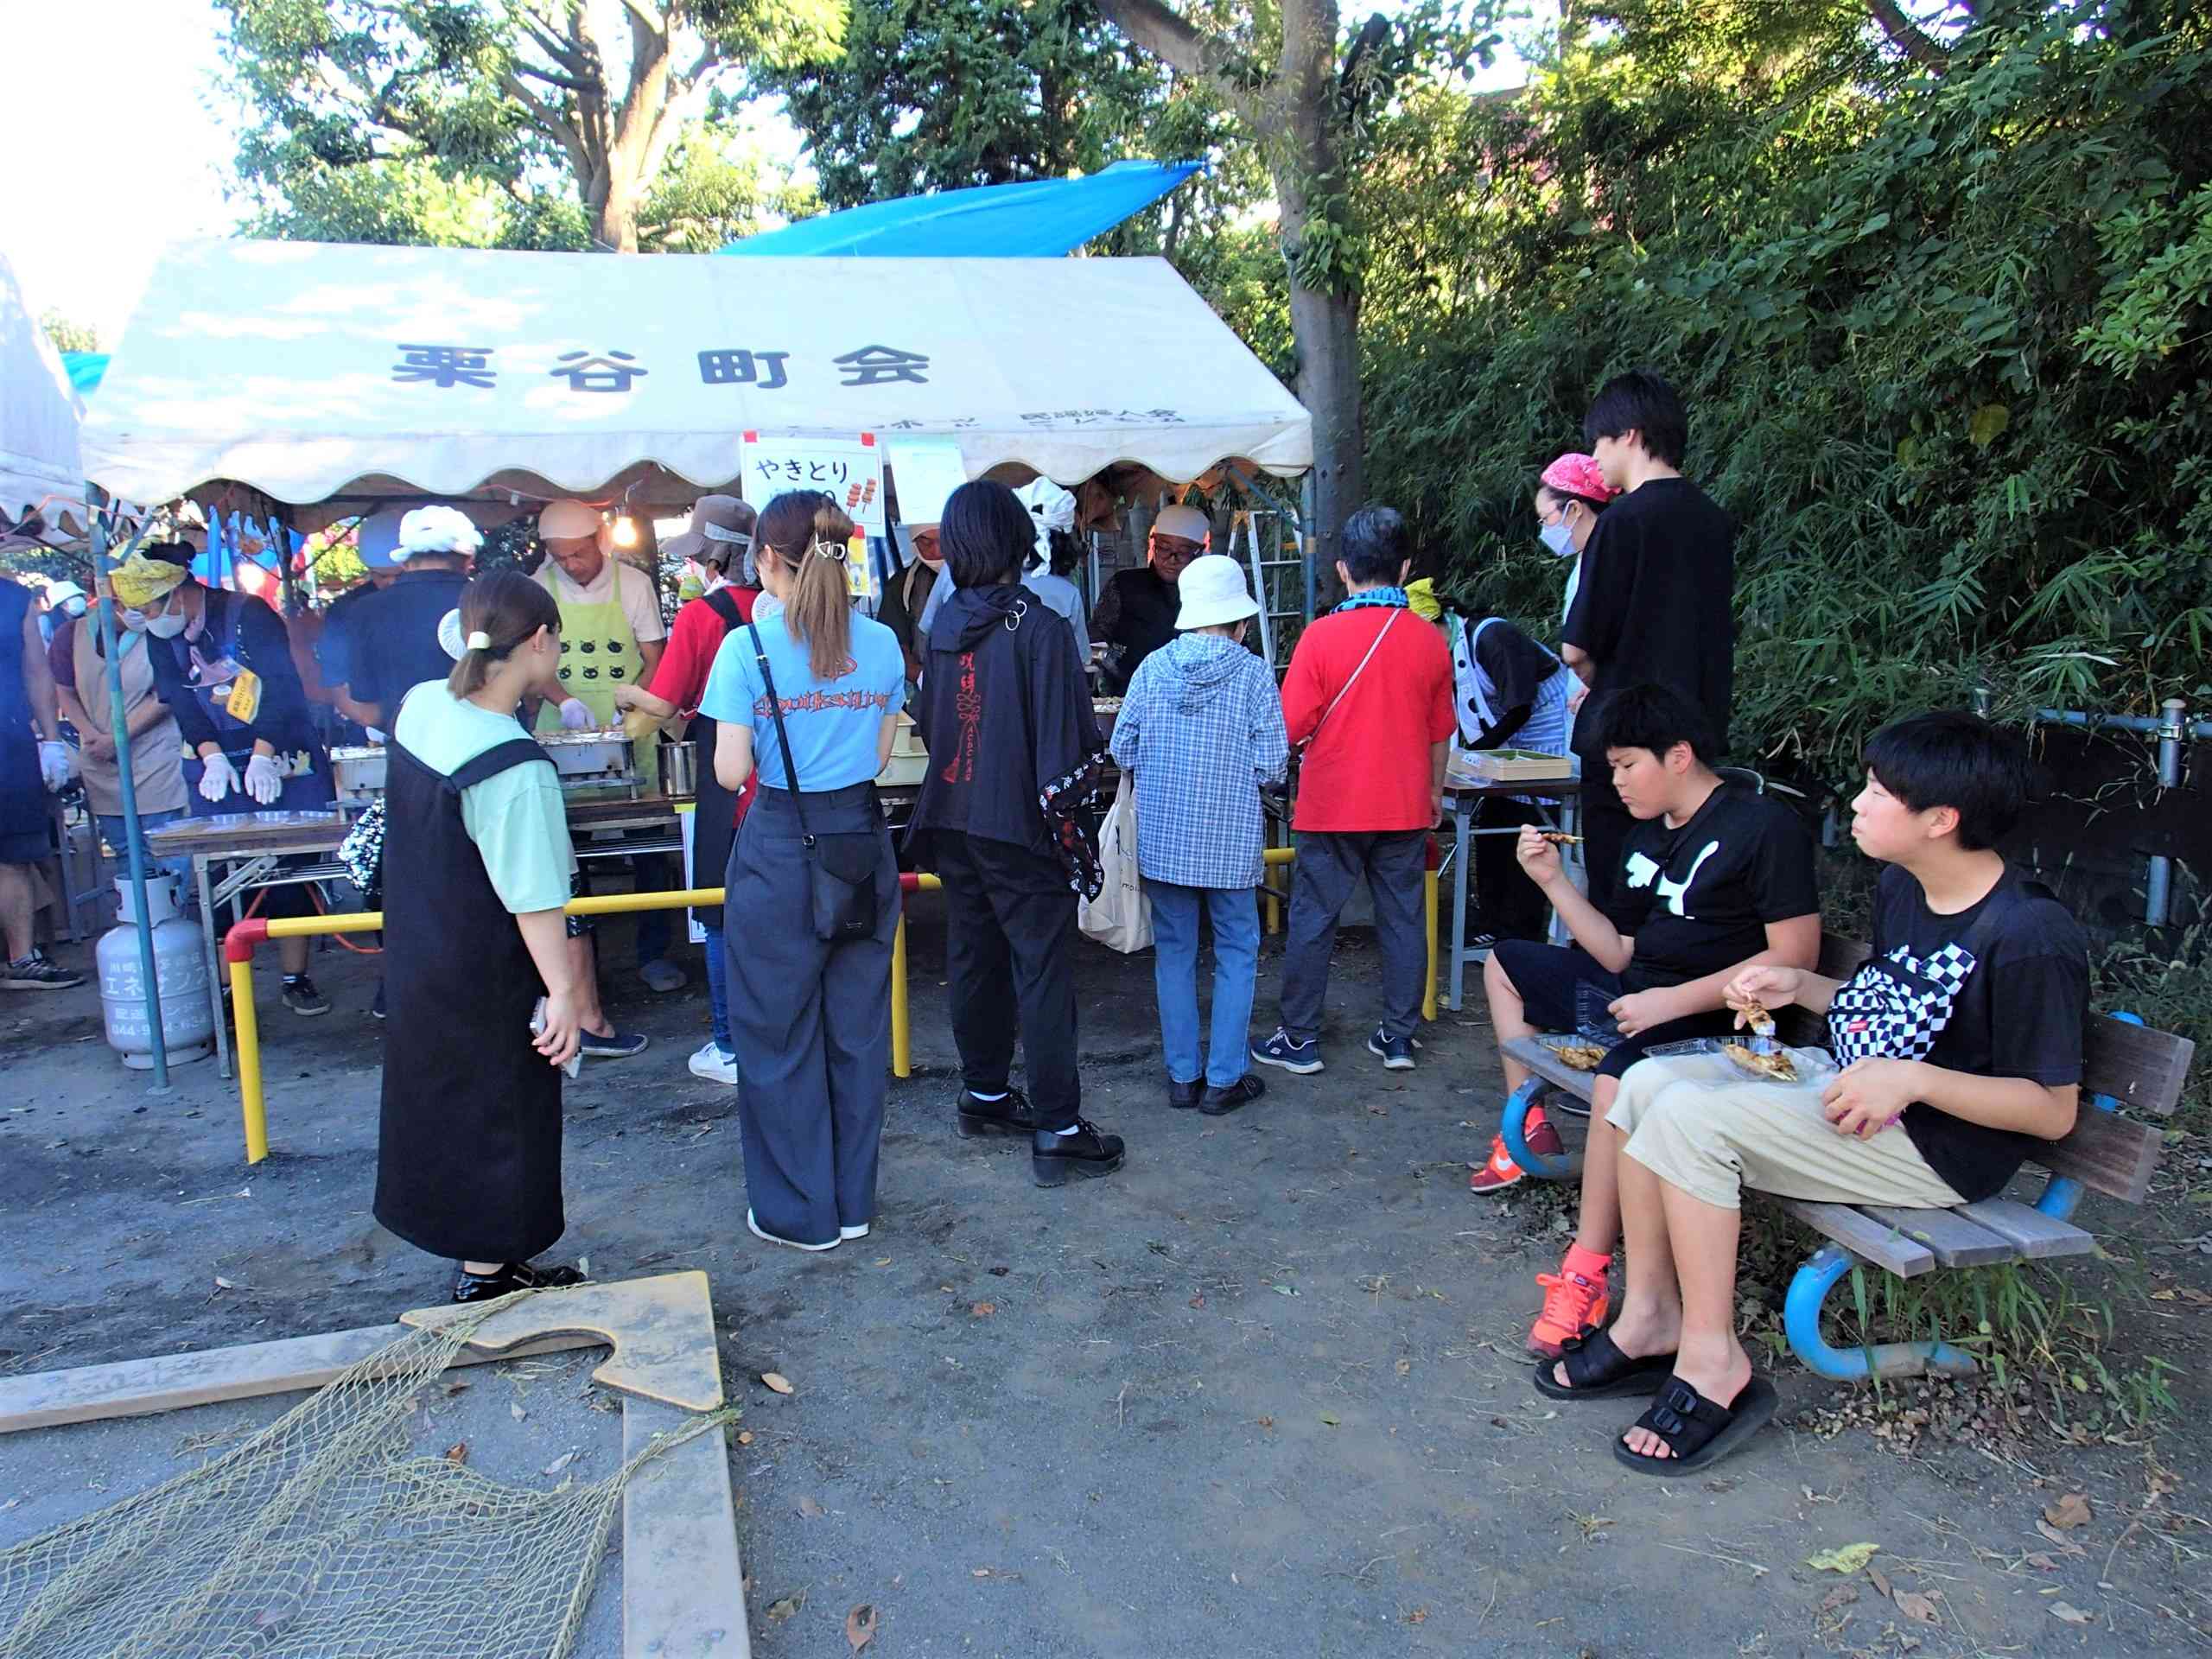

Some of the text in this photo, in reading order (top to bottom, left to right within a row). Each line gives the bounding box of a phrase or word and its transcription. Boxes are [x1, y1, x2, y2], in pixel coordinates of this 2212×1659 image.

[392, 343, 931, 394] 栗谷町会
[756, 458, 848, 484] やきとり
